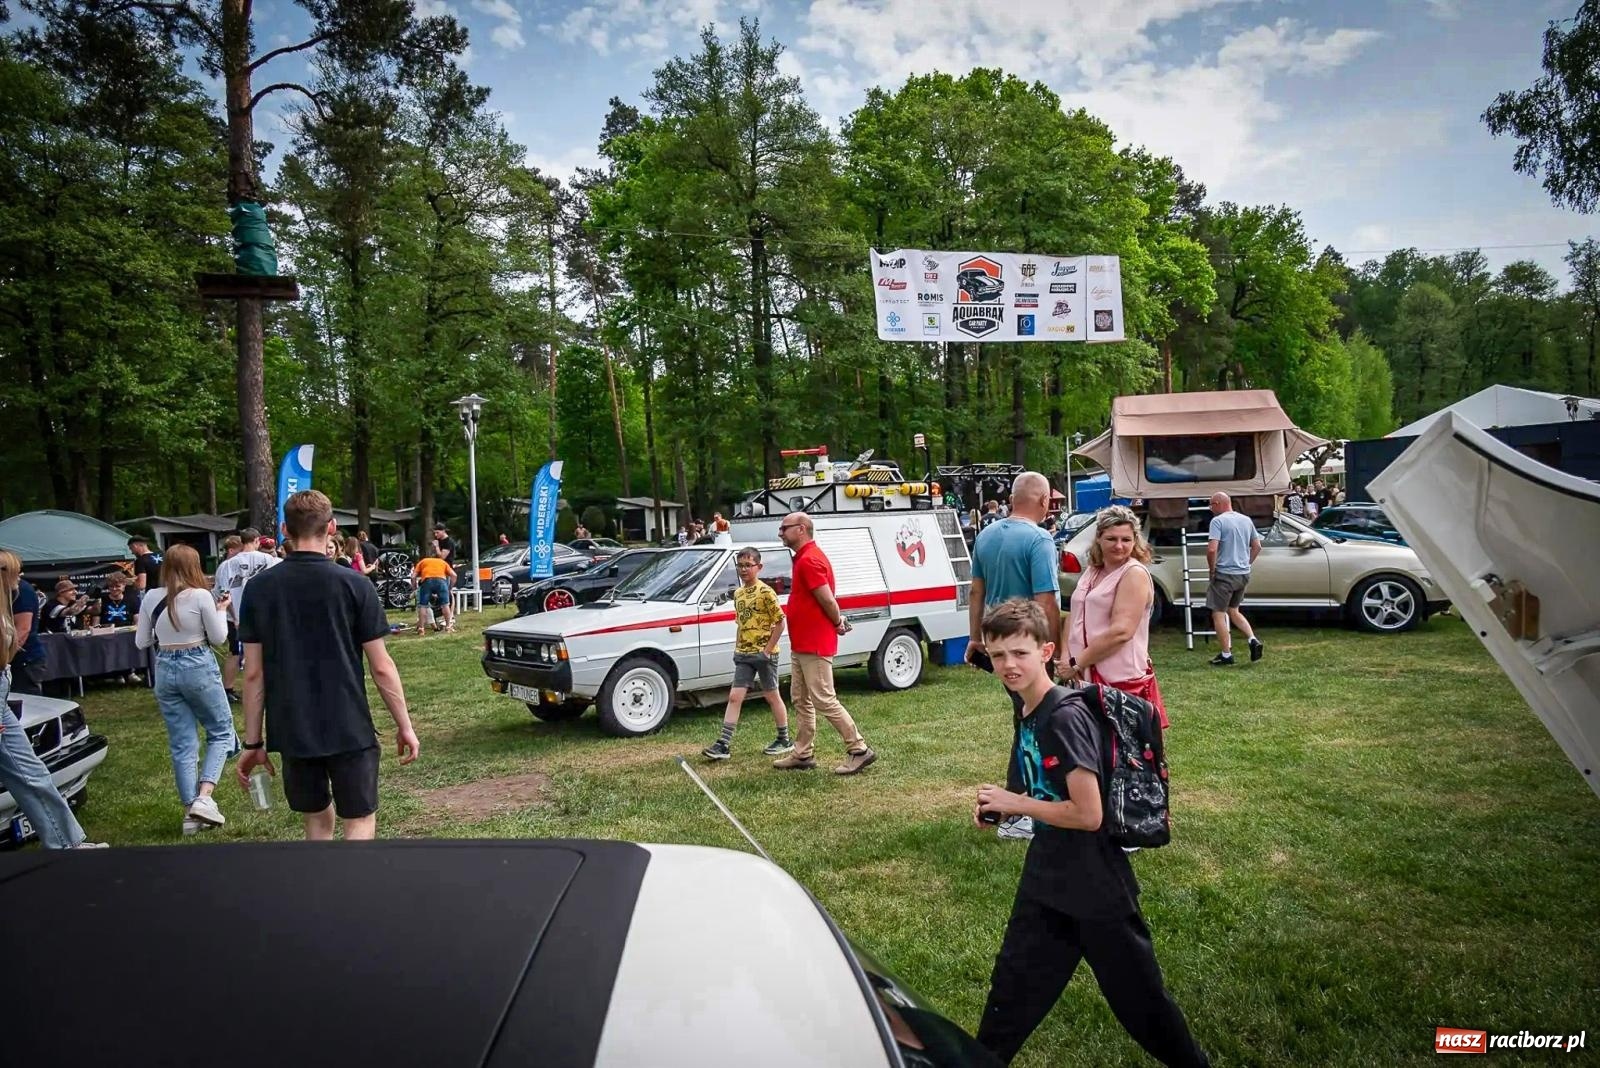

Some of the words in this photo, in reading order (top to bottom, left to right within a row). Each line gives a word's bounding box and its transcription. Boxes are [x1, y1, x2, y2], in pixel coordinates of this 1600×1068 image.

[917, 292, 944, 302] ROMIS
[952, 306, 1004, 323] AQUABRAX
[536, 485, 549, 538] WIDERSKI
